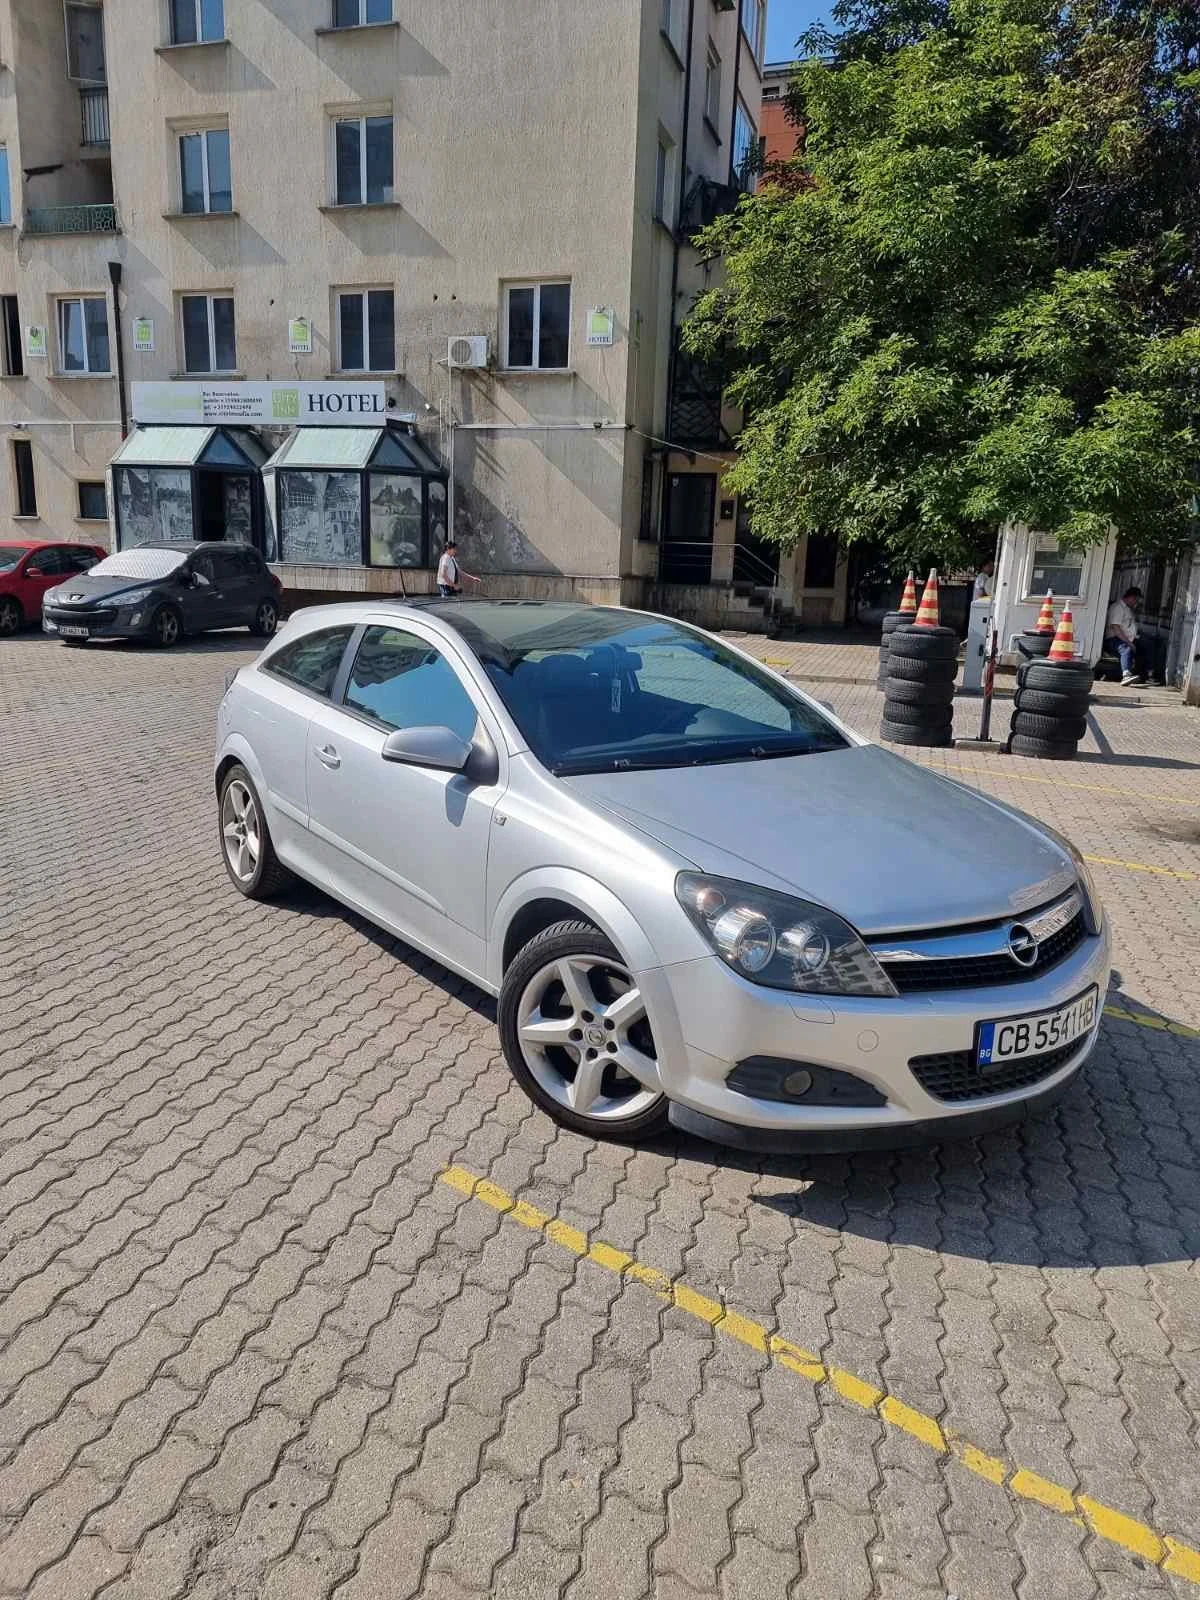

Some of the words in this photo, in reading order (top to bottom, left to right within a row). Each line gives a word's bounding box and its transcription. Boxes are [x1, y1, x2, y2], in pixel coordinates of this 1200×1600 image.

[272, 391, 297, 402] CITY
[307, 393, 385, 413] HOTEL
[997, 1023, 1030, 1056] CB
[1034, 1007, 1077, 1050] 5541
[980, 1048, 991, 1058] BG
